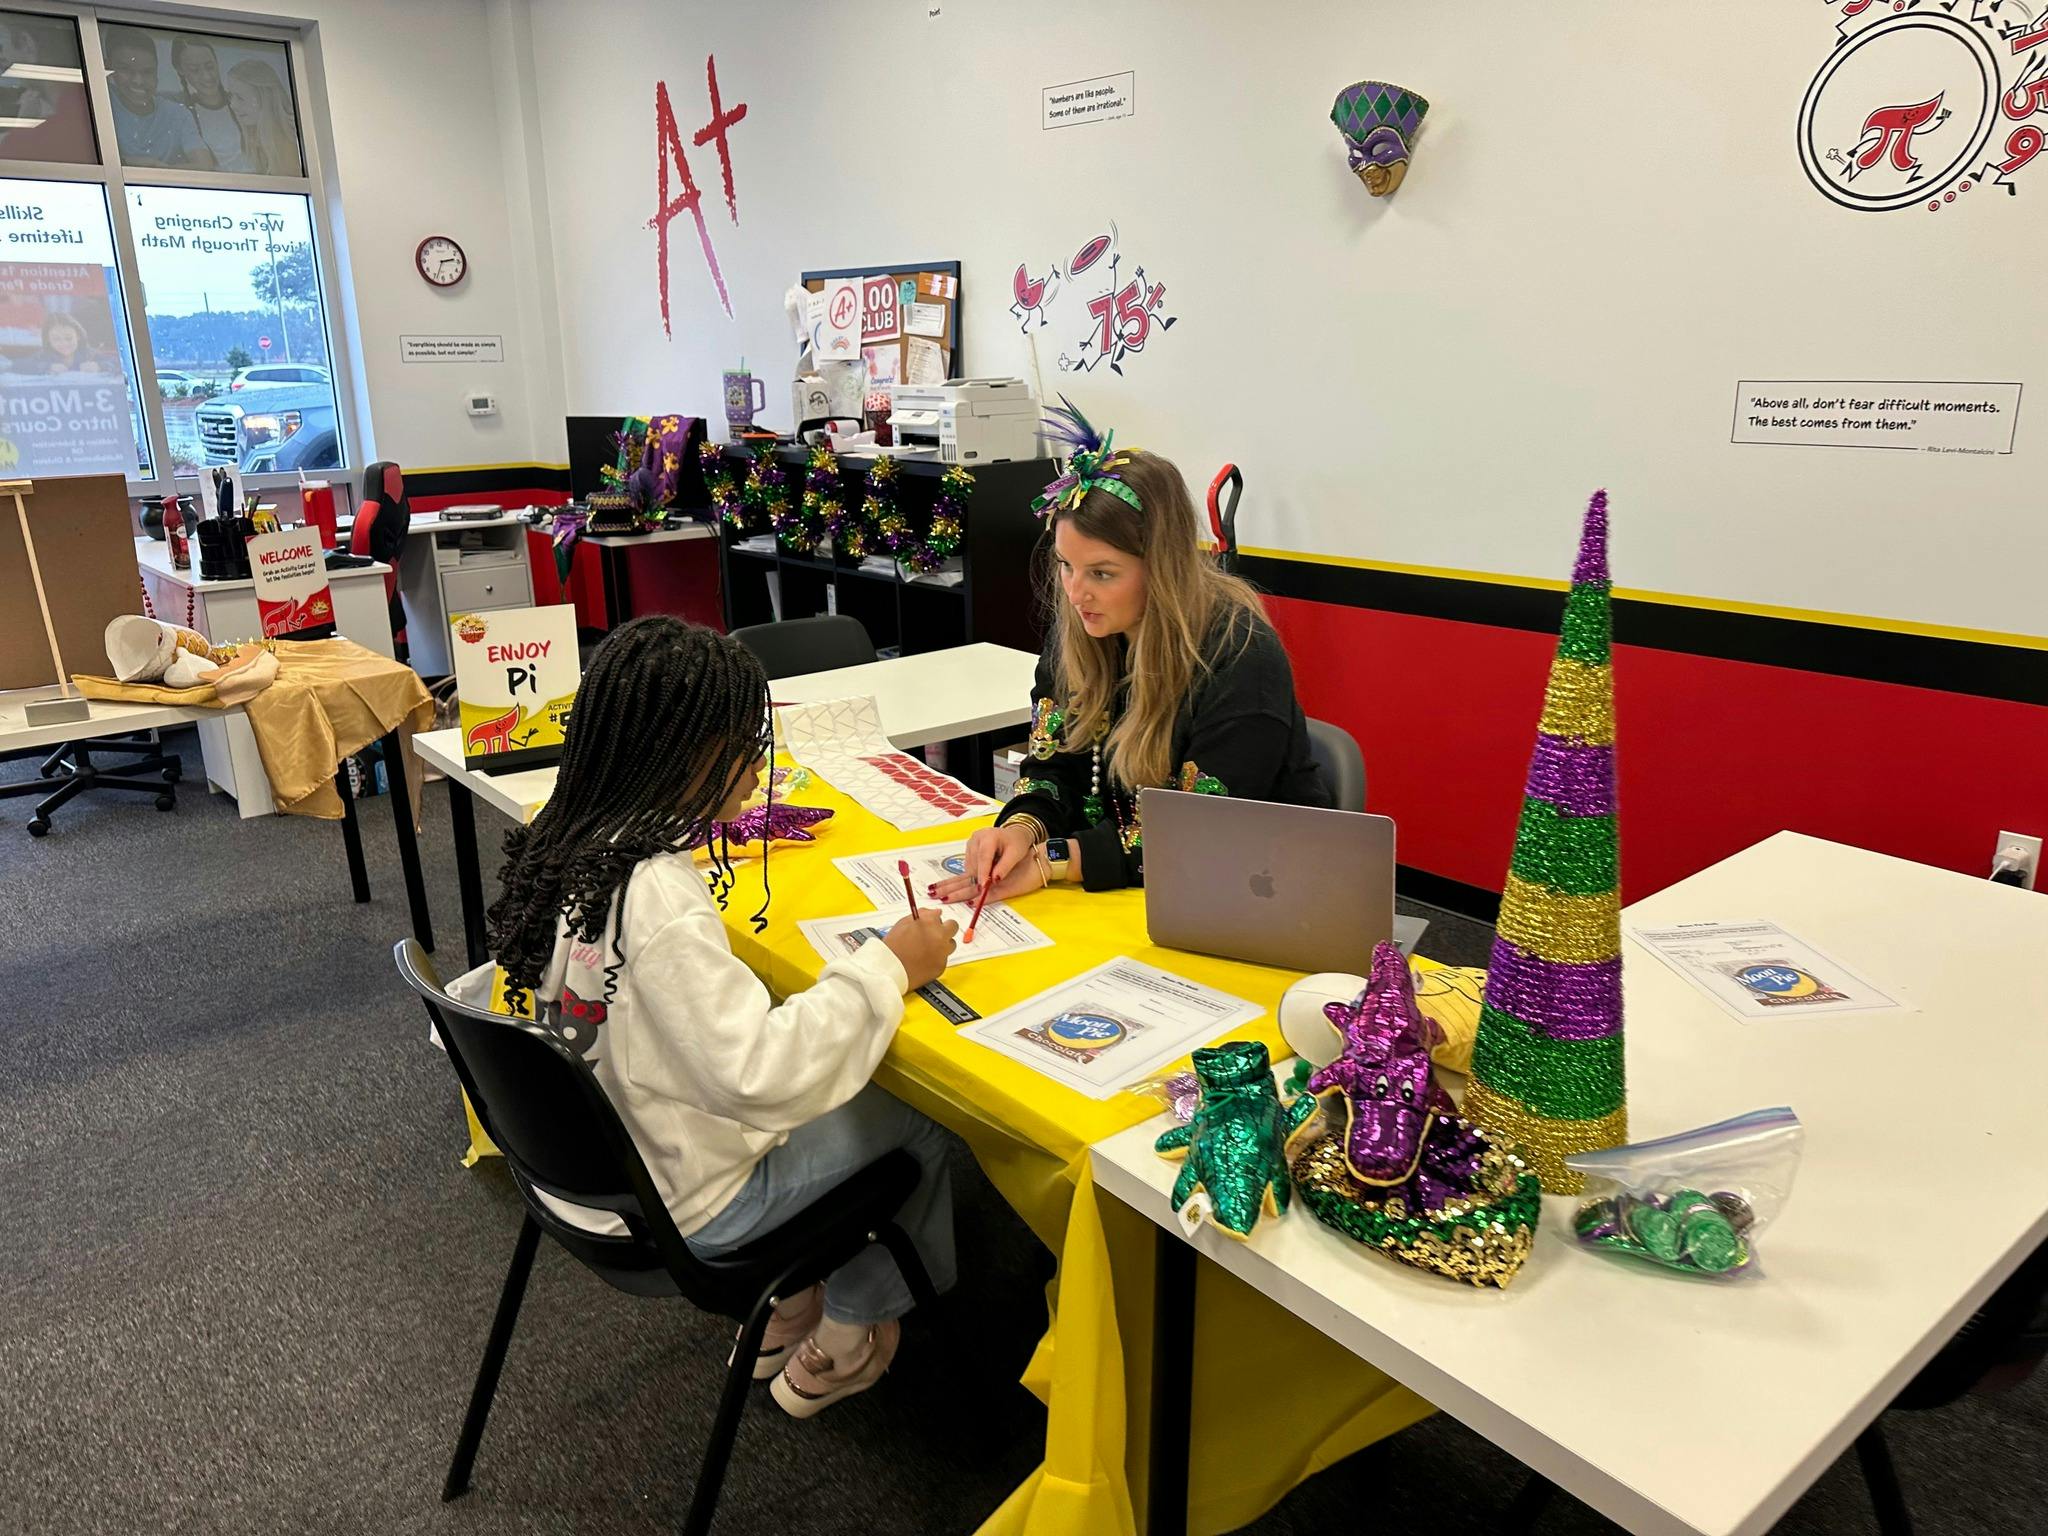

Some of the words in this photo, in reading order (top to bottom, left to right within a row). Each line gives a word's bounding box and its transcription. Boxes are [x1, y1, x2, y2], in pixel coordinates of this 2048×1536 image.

[1075, 92, 1084, 100] are
[1085, 90, 1094, 98] like
[1095, 86, 1115, 97] people.
[1049, 110, 1064, 118] Some
[1065, 107, 1071, 116] of
[1072, 106, 1085, 115] them
[1087, 104, 1095, 112] are
[643, 53, 747, 342] A+
[864, 283, 893, 312] 00
[835, 295, 853, 323] A+
[1087, 279, 1166, 356] 75%
[1792, 398, 1809, 410] all,
[1812, 398, 1845, 410] don't
[1849, 399, 1874, 410] fear
[1877, 399, 1930, 411] difficult
[1934, 401, 2000, 413] moments.
[1749, 416, 1768, 427] The
[1771, 416, 1797, 428] best
[1800, 418, 1838, 428] comes
[1842, 417, 1872, 429] from
[260, 545, 313, 565] WELCOME
[487, 640, 551, 663] ENJOY
[506, 663, 537, 696] Pi
[548, 703, 575, 711] ACTIVIT
[570, 943, 602, 970] itty
[1735, 968, 1777, 985] Moon
[1770, 972, 1798, 985] Pie
[1057, 1013, 1112, 1029] Moon
[1075, 1026, 1110, 1039] Pie
